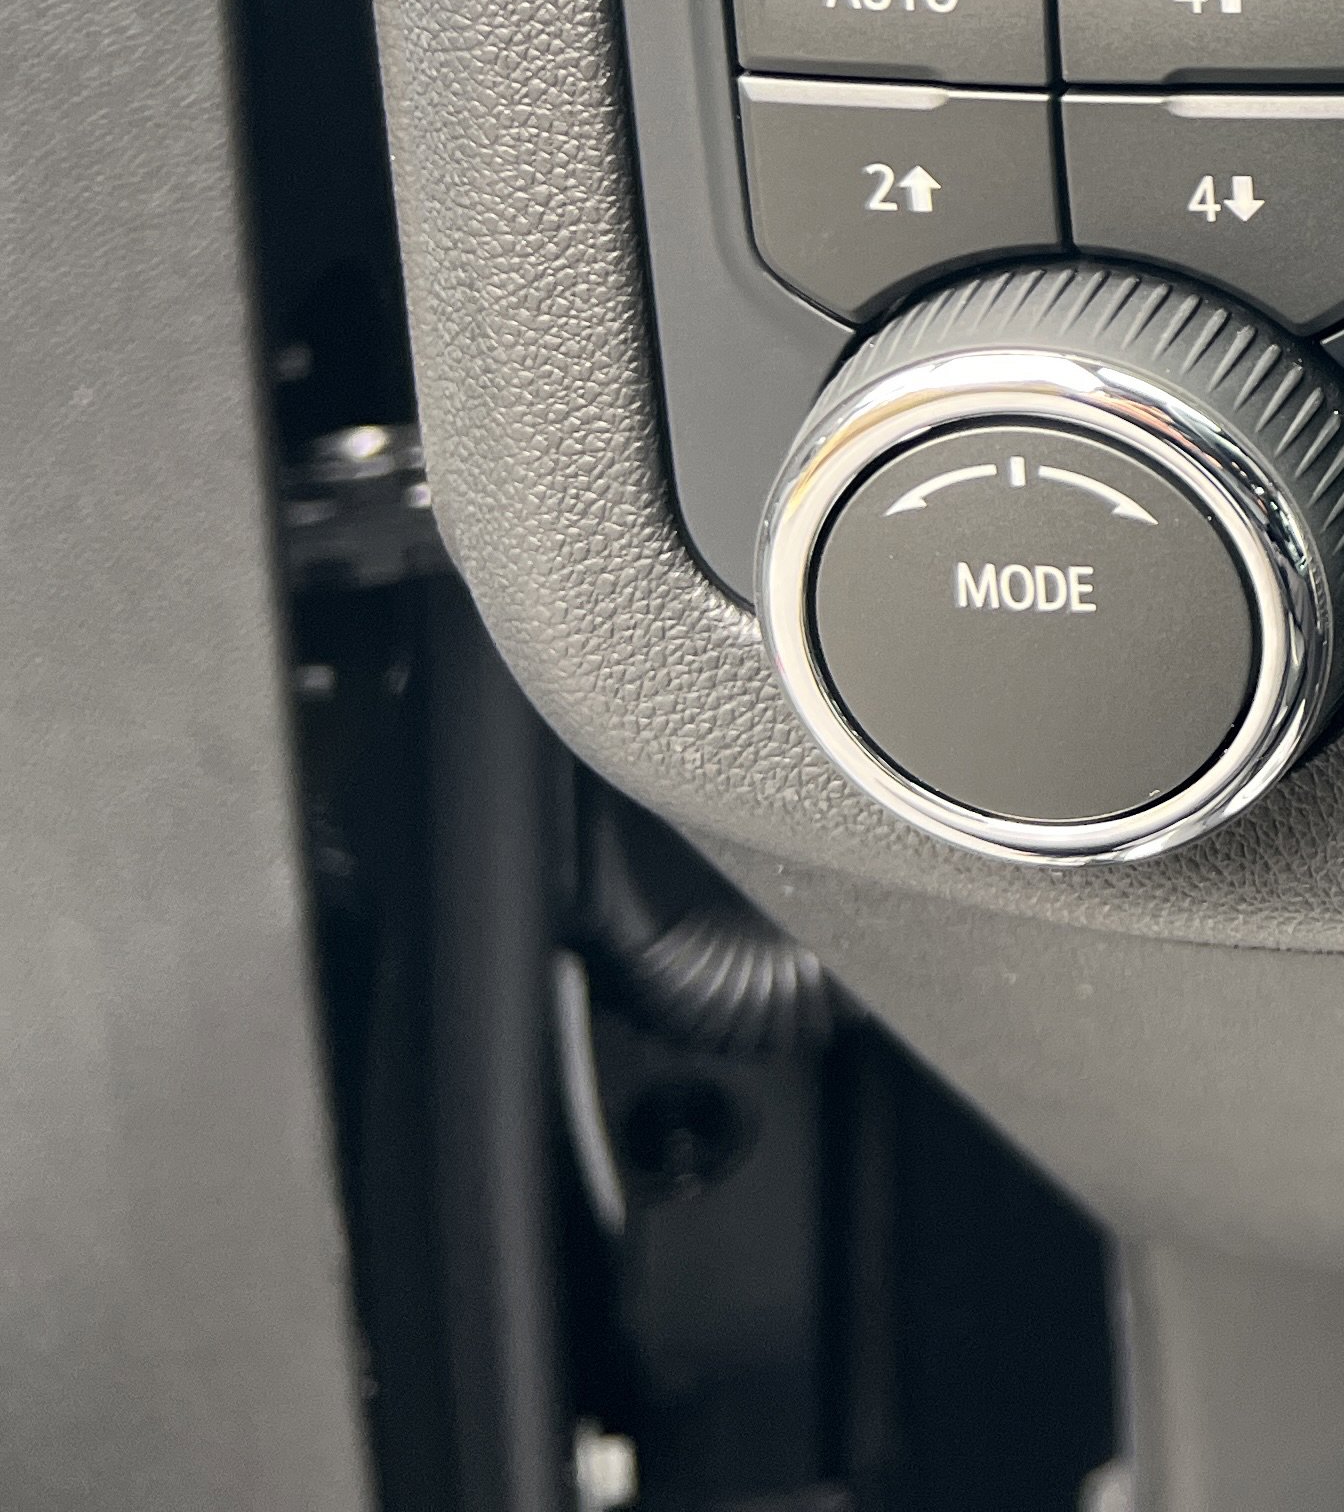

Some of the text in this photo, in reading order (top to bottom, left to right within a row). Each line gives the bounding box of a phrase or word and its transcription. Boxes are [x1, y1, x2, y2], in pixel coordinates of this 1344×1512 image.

[863, 163, 898, 211] 2
[1188, 176, 1222, 222] 4
[956, 561, 1097, 612] MODE
